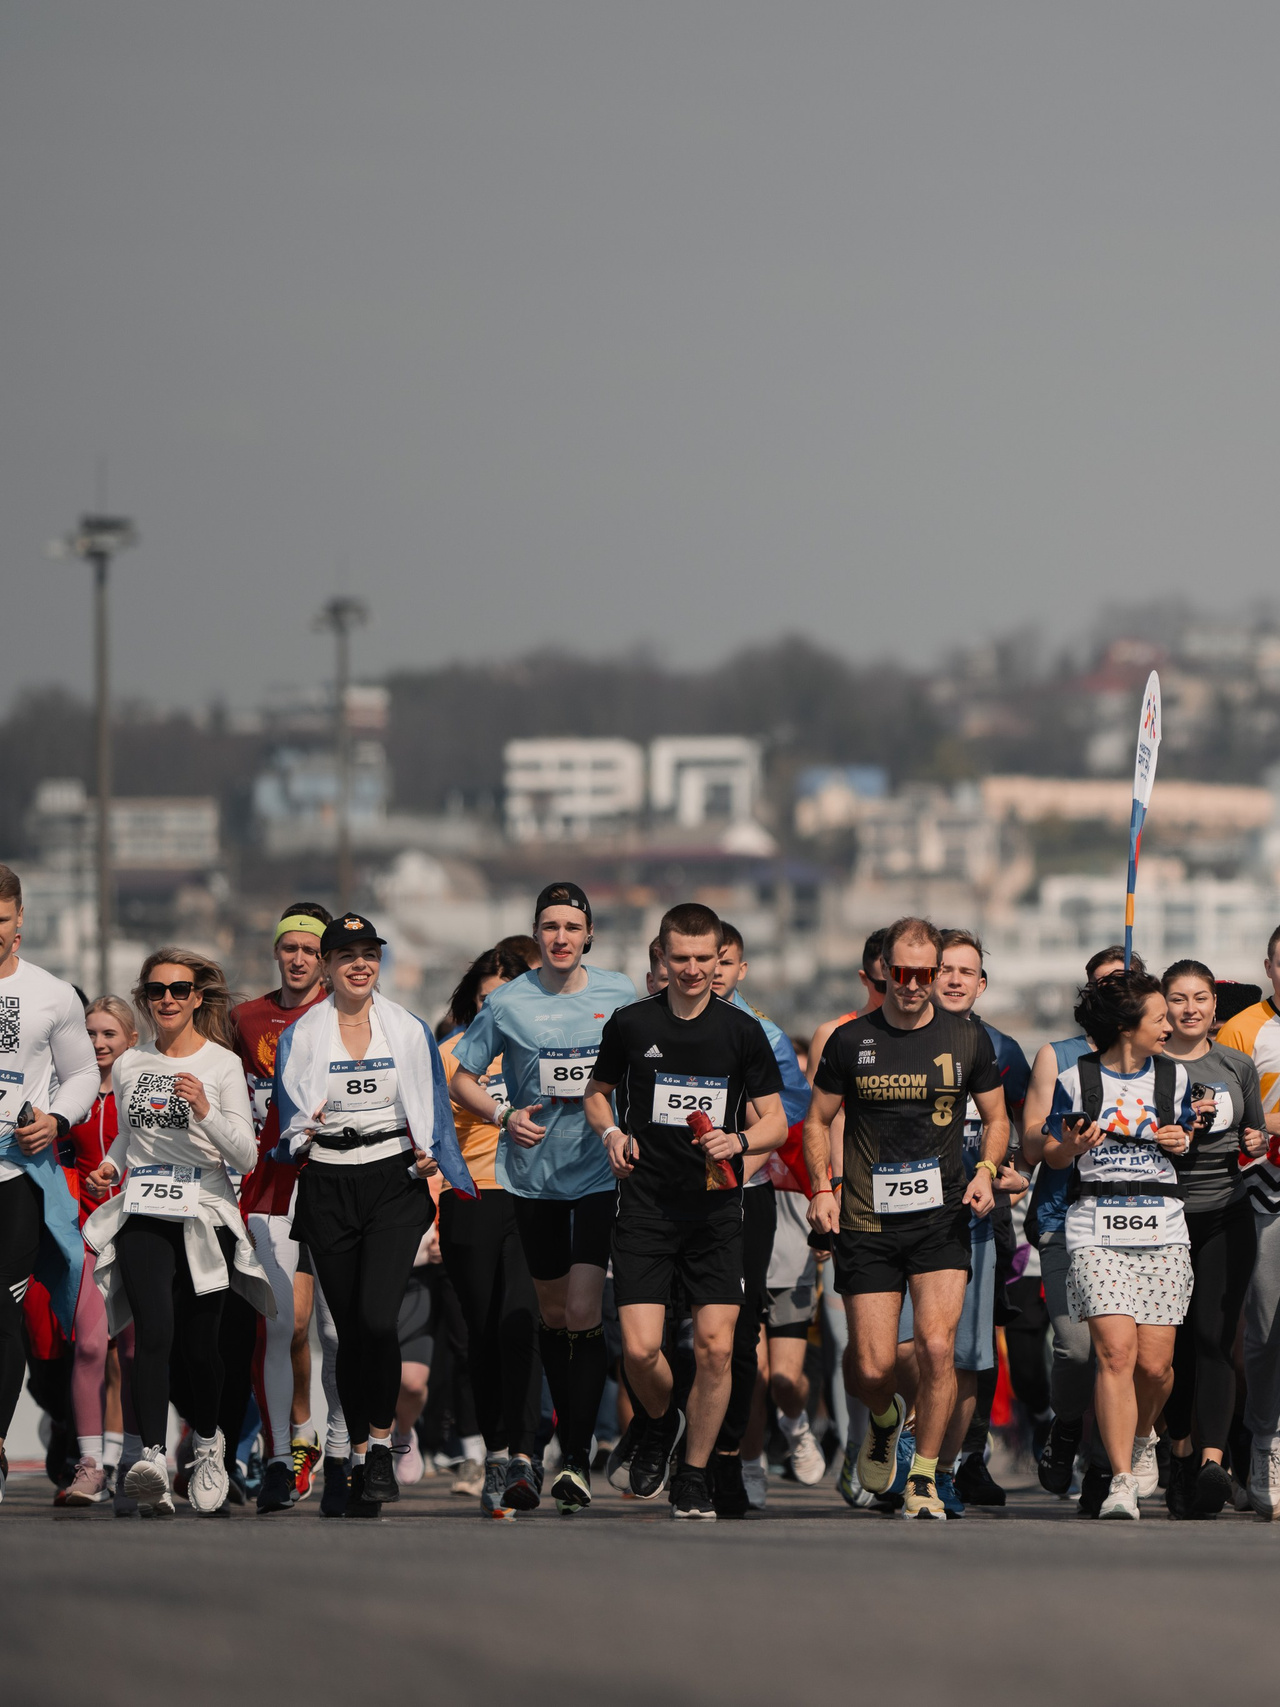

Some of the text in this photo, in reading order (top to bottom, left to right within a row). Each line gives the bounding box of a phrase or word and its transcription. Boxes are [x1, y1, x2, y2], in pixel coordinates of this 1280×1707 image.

[857, 1056, 876, 1065] STAR
[553, 1065, 595, 1082] 867
[933, 1053, 954, 1086] 1
[346, 1078, 378, 1095] 85
[855, 1074, 928, 1089] MOSCOW
[858, 1087, 928, 1100] LUZHNIKI
[667, 1093, 713, 1112] 526
[931, 1096, 957, 1127] 8
[1089, 1144, 1162, 1157] НАВСТРЕ
[140, 1183, 184, 1200] 755
[885, 1178, 929, 1198] 758
[1102, 1214, 1159, 1231] 1864
